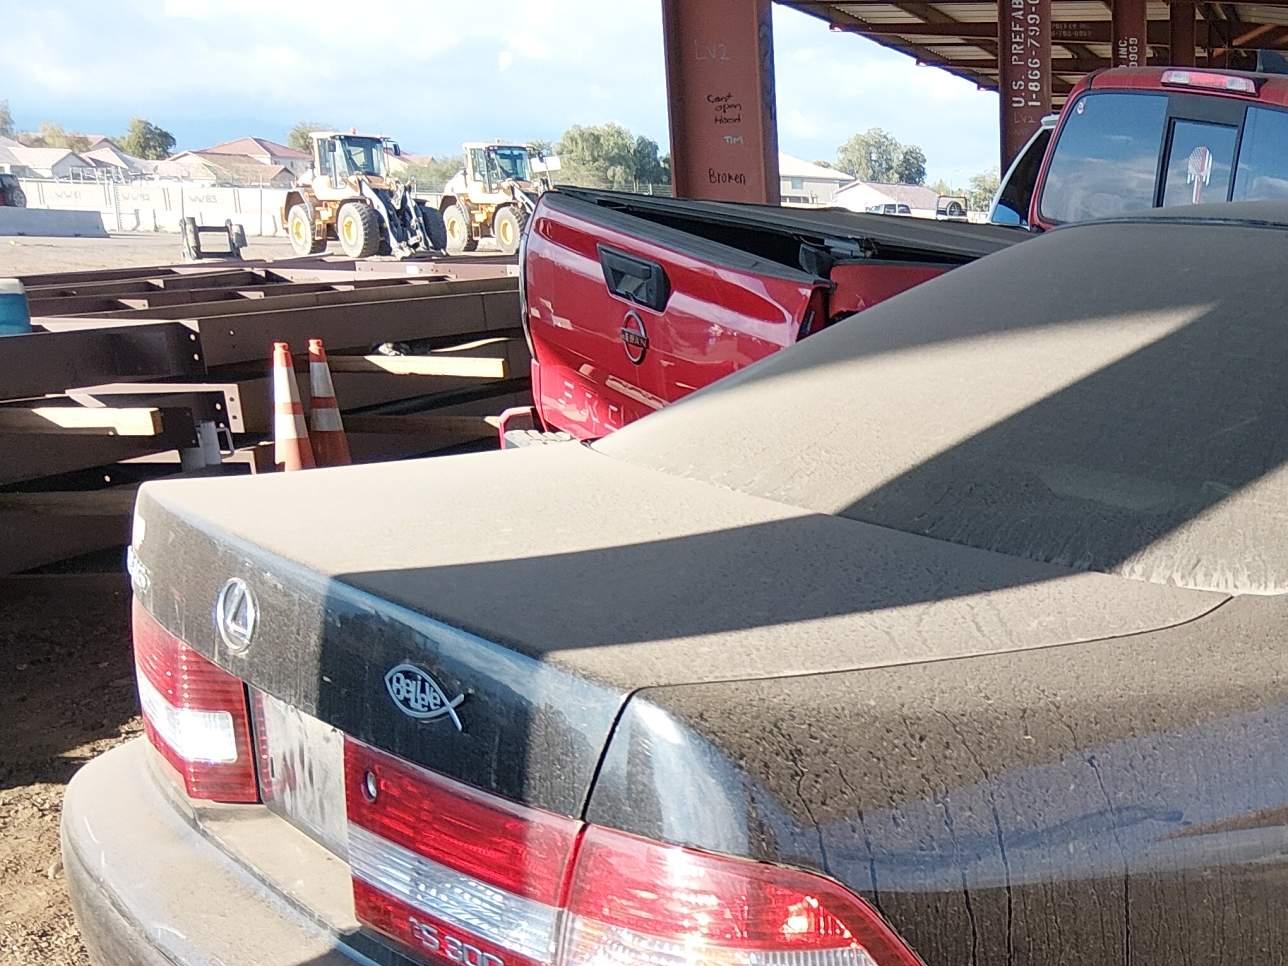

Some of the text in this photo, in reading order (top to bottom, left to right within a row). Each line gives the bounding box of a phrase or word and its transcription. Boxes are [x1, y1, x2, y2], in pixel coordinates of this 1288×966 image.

[1118, 36, 1128, 59] INC.
[1012, 75, 1025, 107] U.S.
[708, 167, 746, 185] Broken
